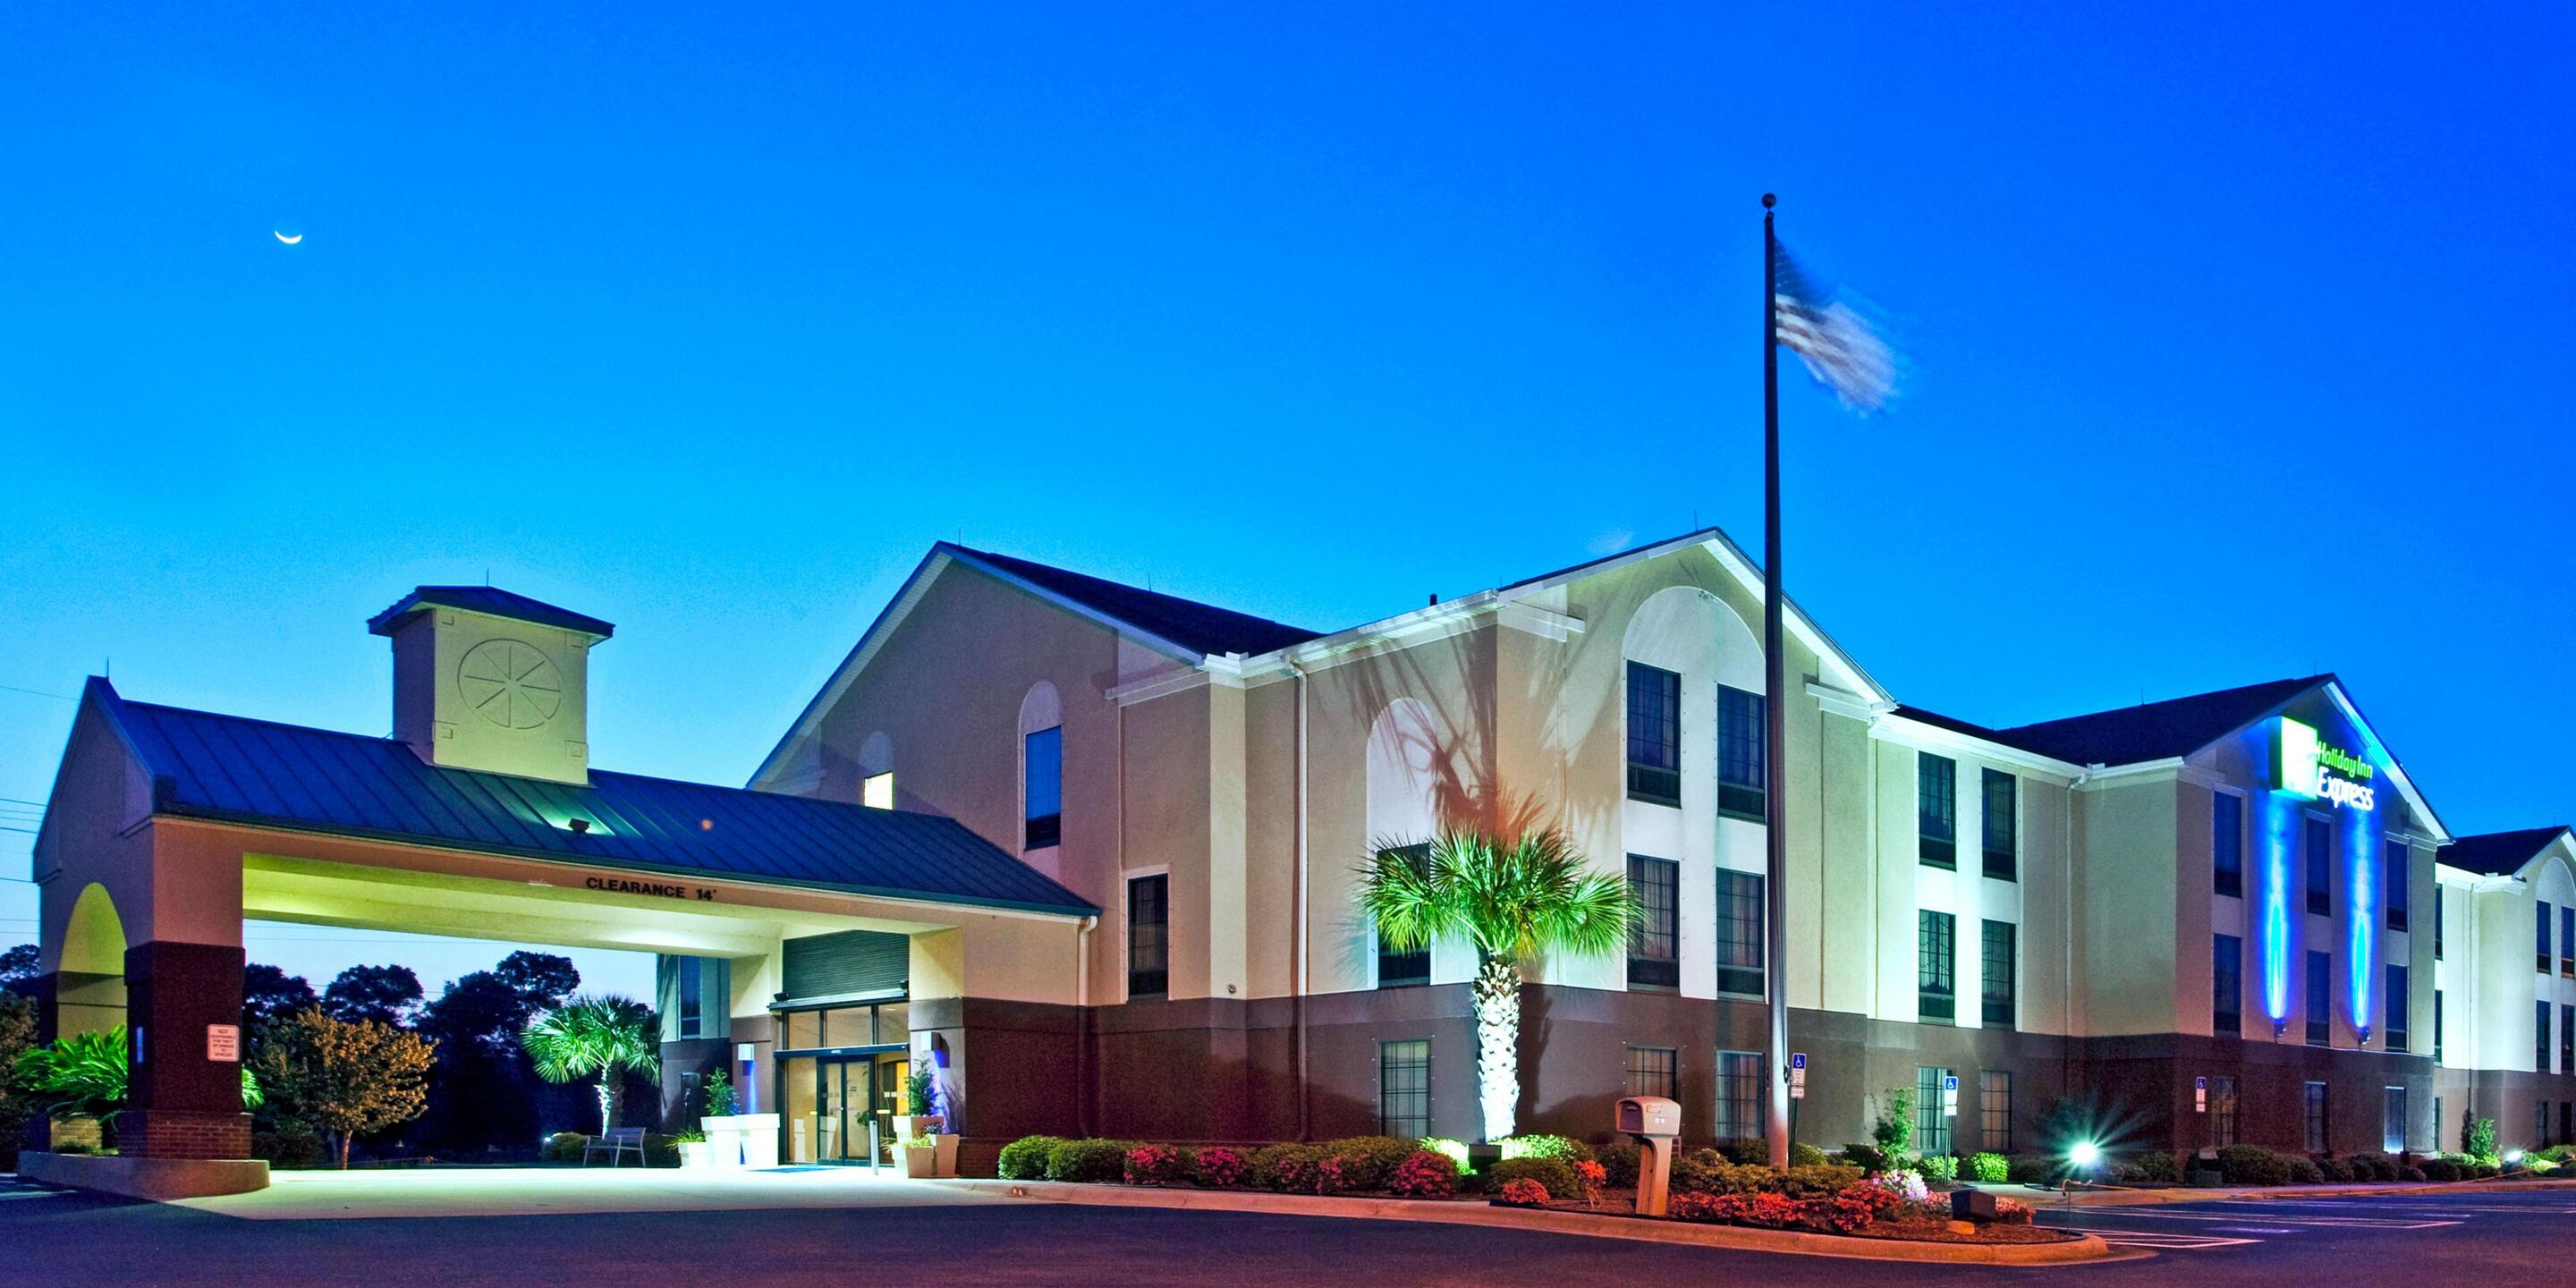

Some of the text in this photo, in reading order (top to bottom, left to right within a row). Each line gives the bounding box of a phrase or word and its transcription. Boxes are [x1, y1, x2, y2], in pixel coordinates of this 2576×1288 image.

[2316, 741, 2373, 779] Holiday Inn
[2318, 766, 2374, 811] Express
[586, 877, 686, 898] CLEARANCE
